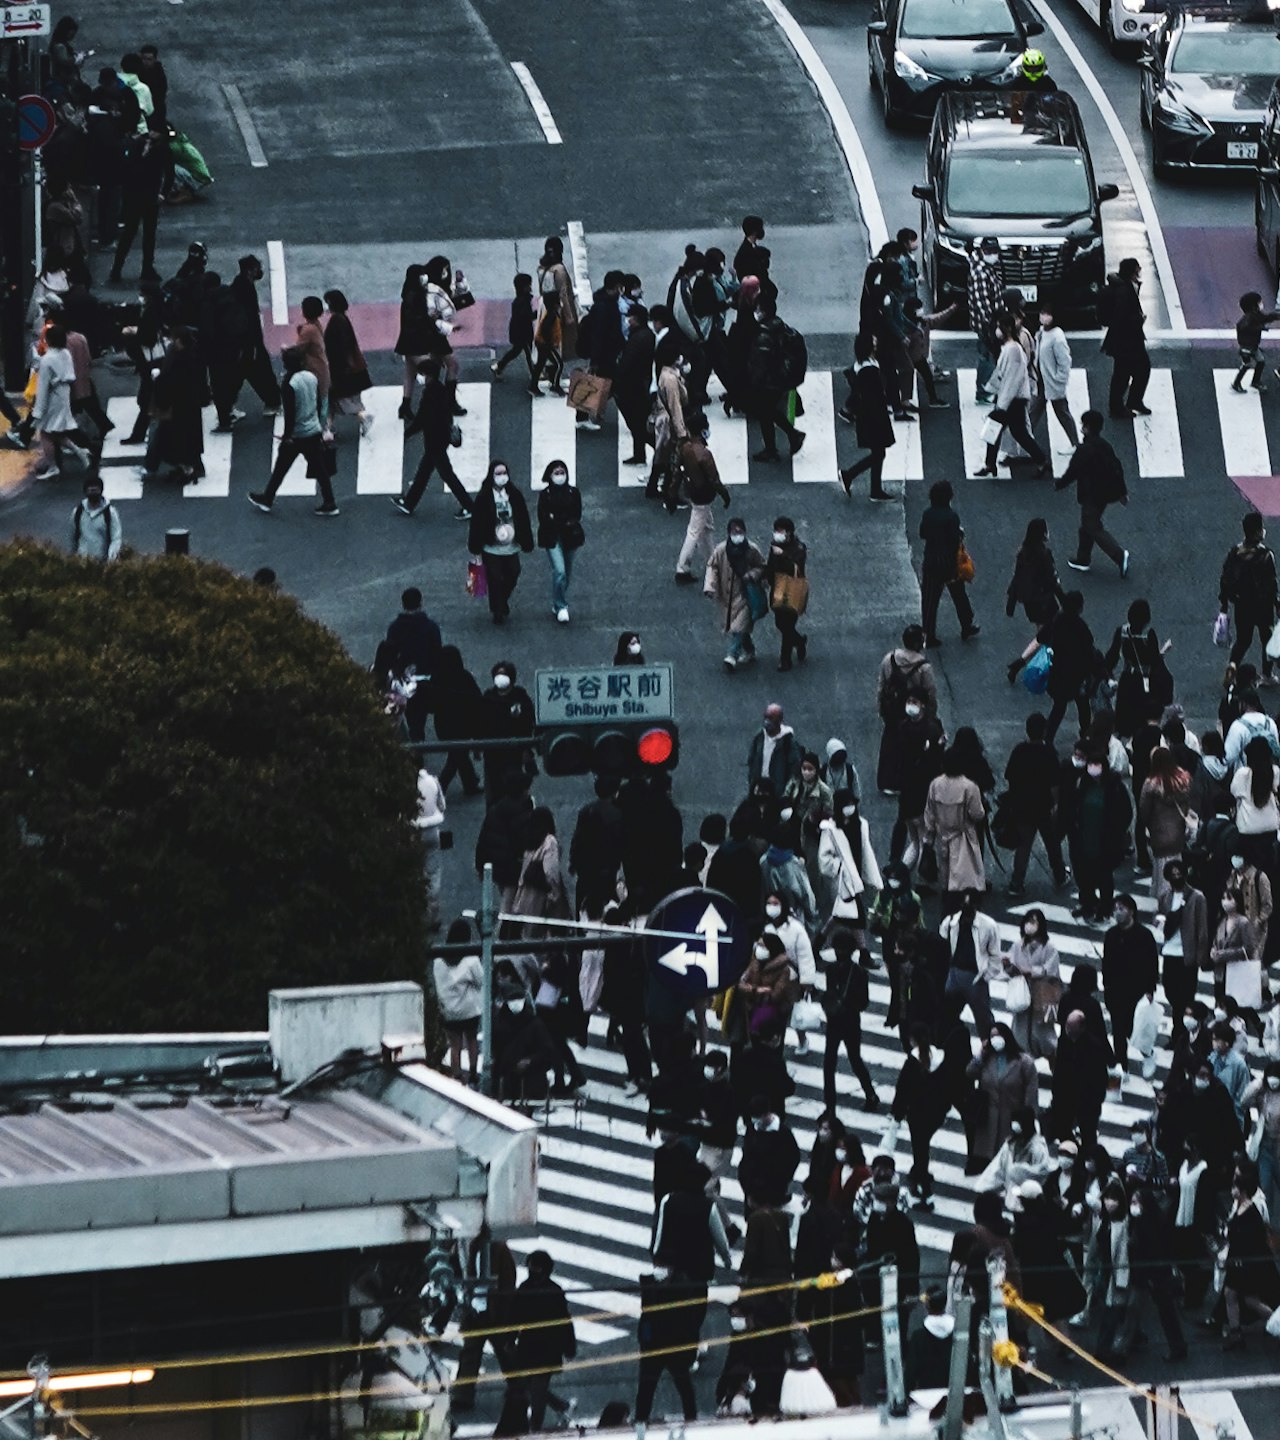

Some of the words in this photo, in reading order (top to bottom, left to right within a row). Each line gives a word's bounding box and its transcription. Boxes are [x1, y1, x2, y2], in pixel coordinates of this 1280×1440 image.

[547, 673, 663, 702] 渋谷駅前
[565, 701, 619, 720] Shibuya
[622, 701, 650, 717] Sta.
